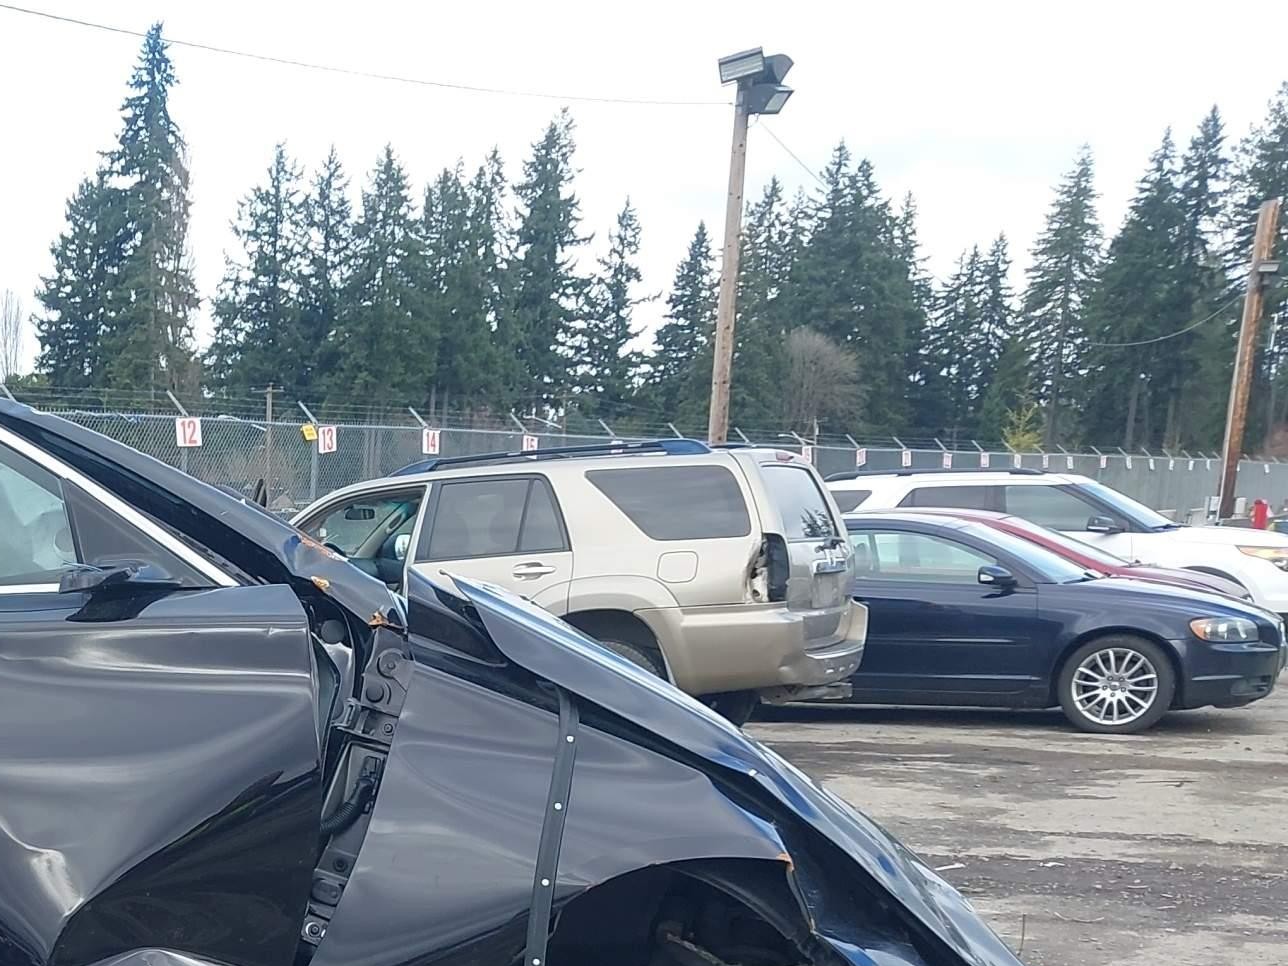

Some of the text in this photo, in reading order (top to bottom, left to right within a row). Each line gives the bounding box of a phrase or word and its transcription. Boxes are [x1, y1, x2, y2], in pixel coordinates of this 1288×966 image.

[181, 420, 197, 445] 12
[322, 428, 334, 451] 13
[426, 431, 436, 452] 14
